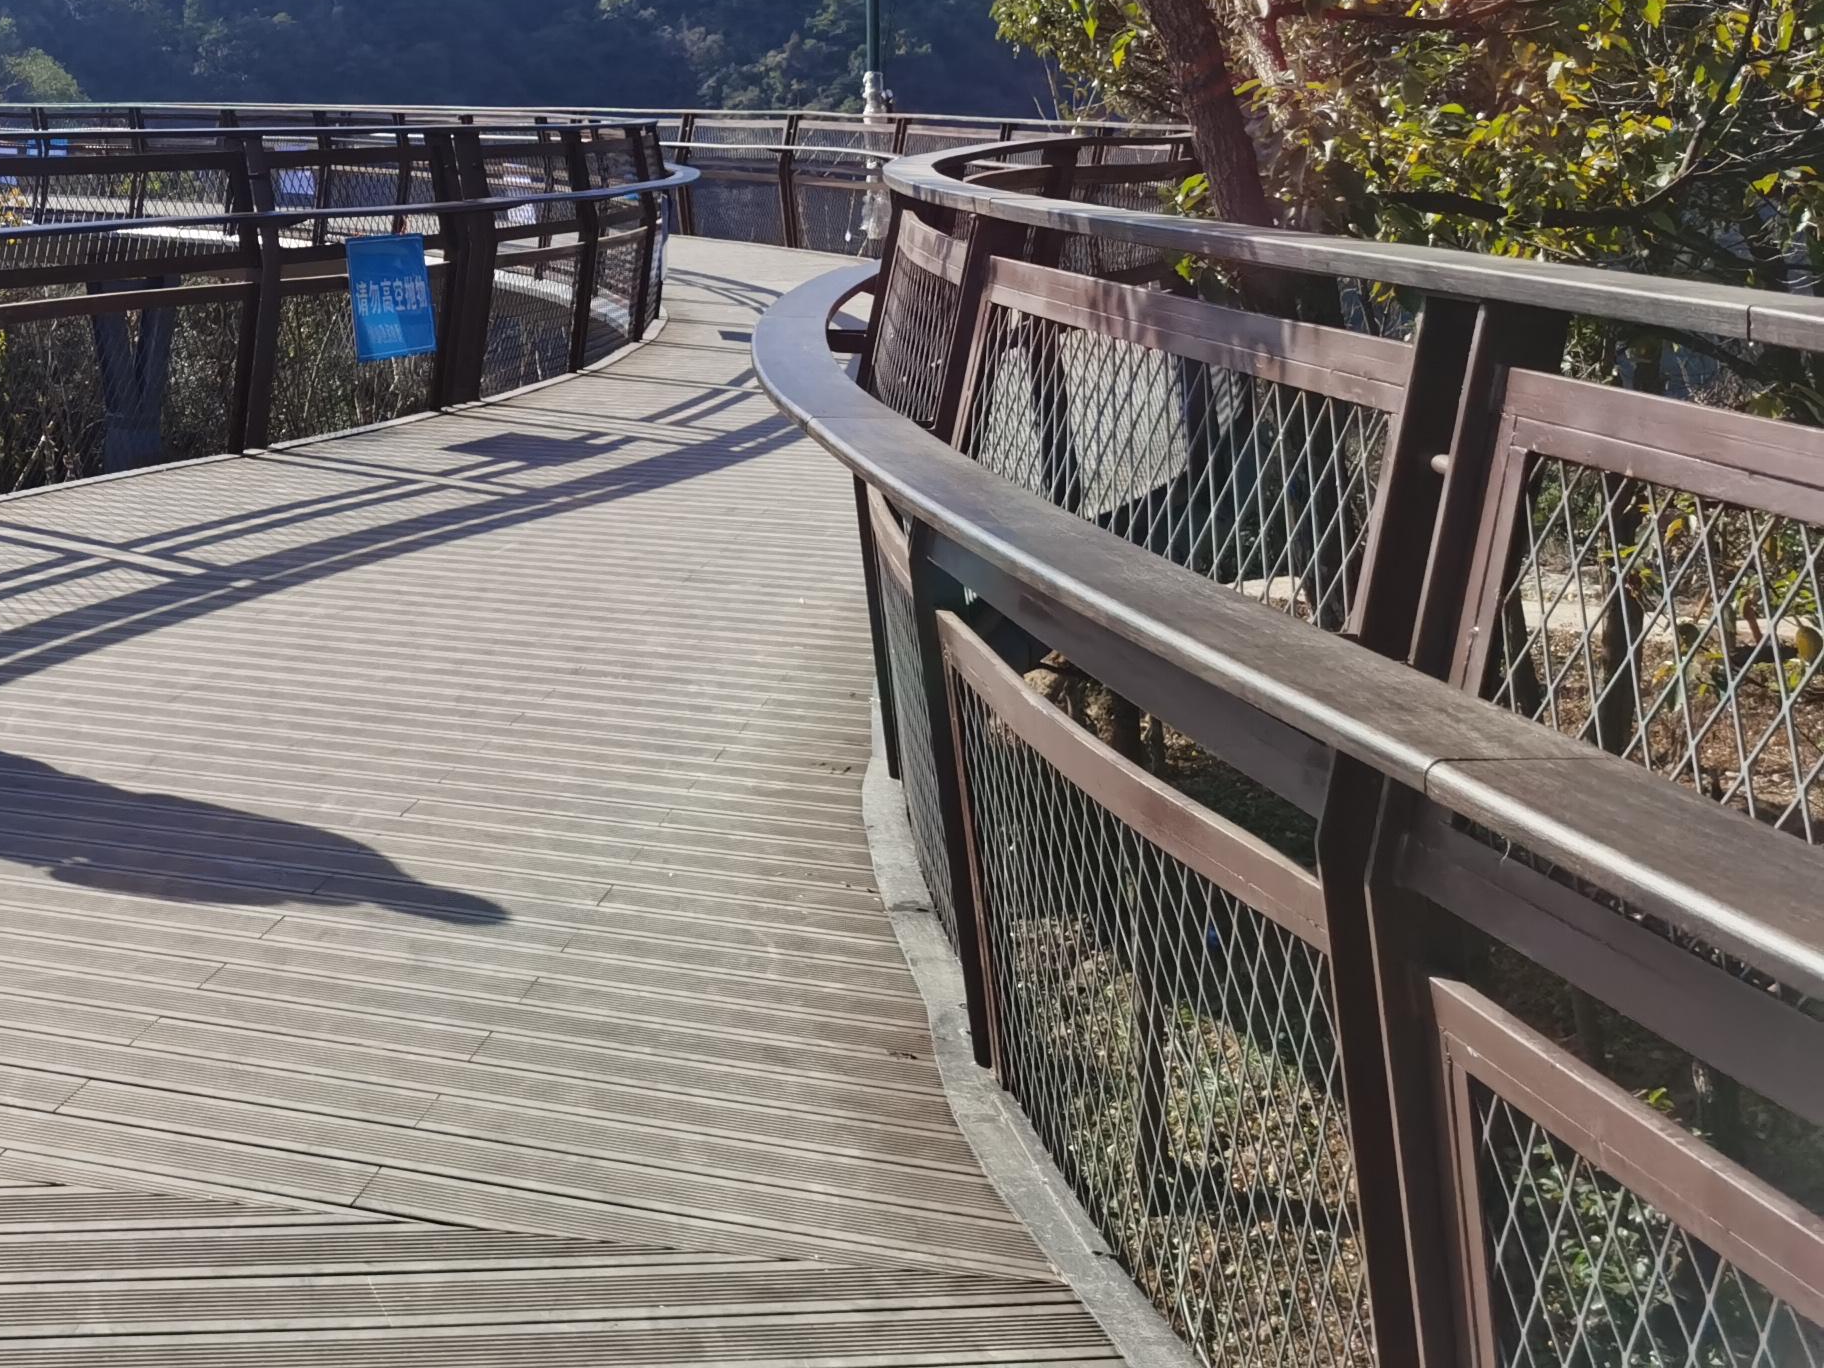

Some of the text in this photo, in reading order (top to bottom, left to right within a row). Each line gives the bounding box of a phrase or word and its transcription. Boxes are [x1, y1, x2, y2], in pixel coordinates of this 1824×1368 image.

[355, 275, 428, 317] 请勿高空抛物
